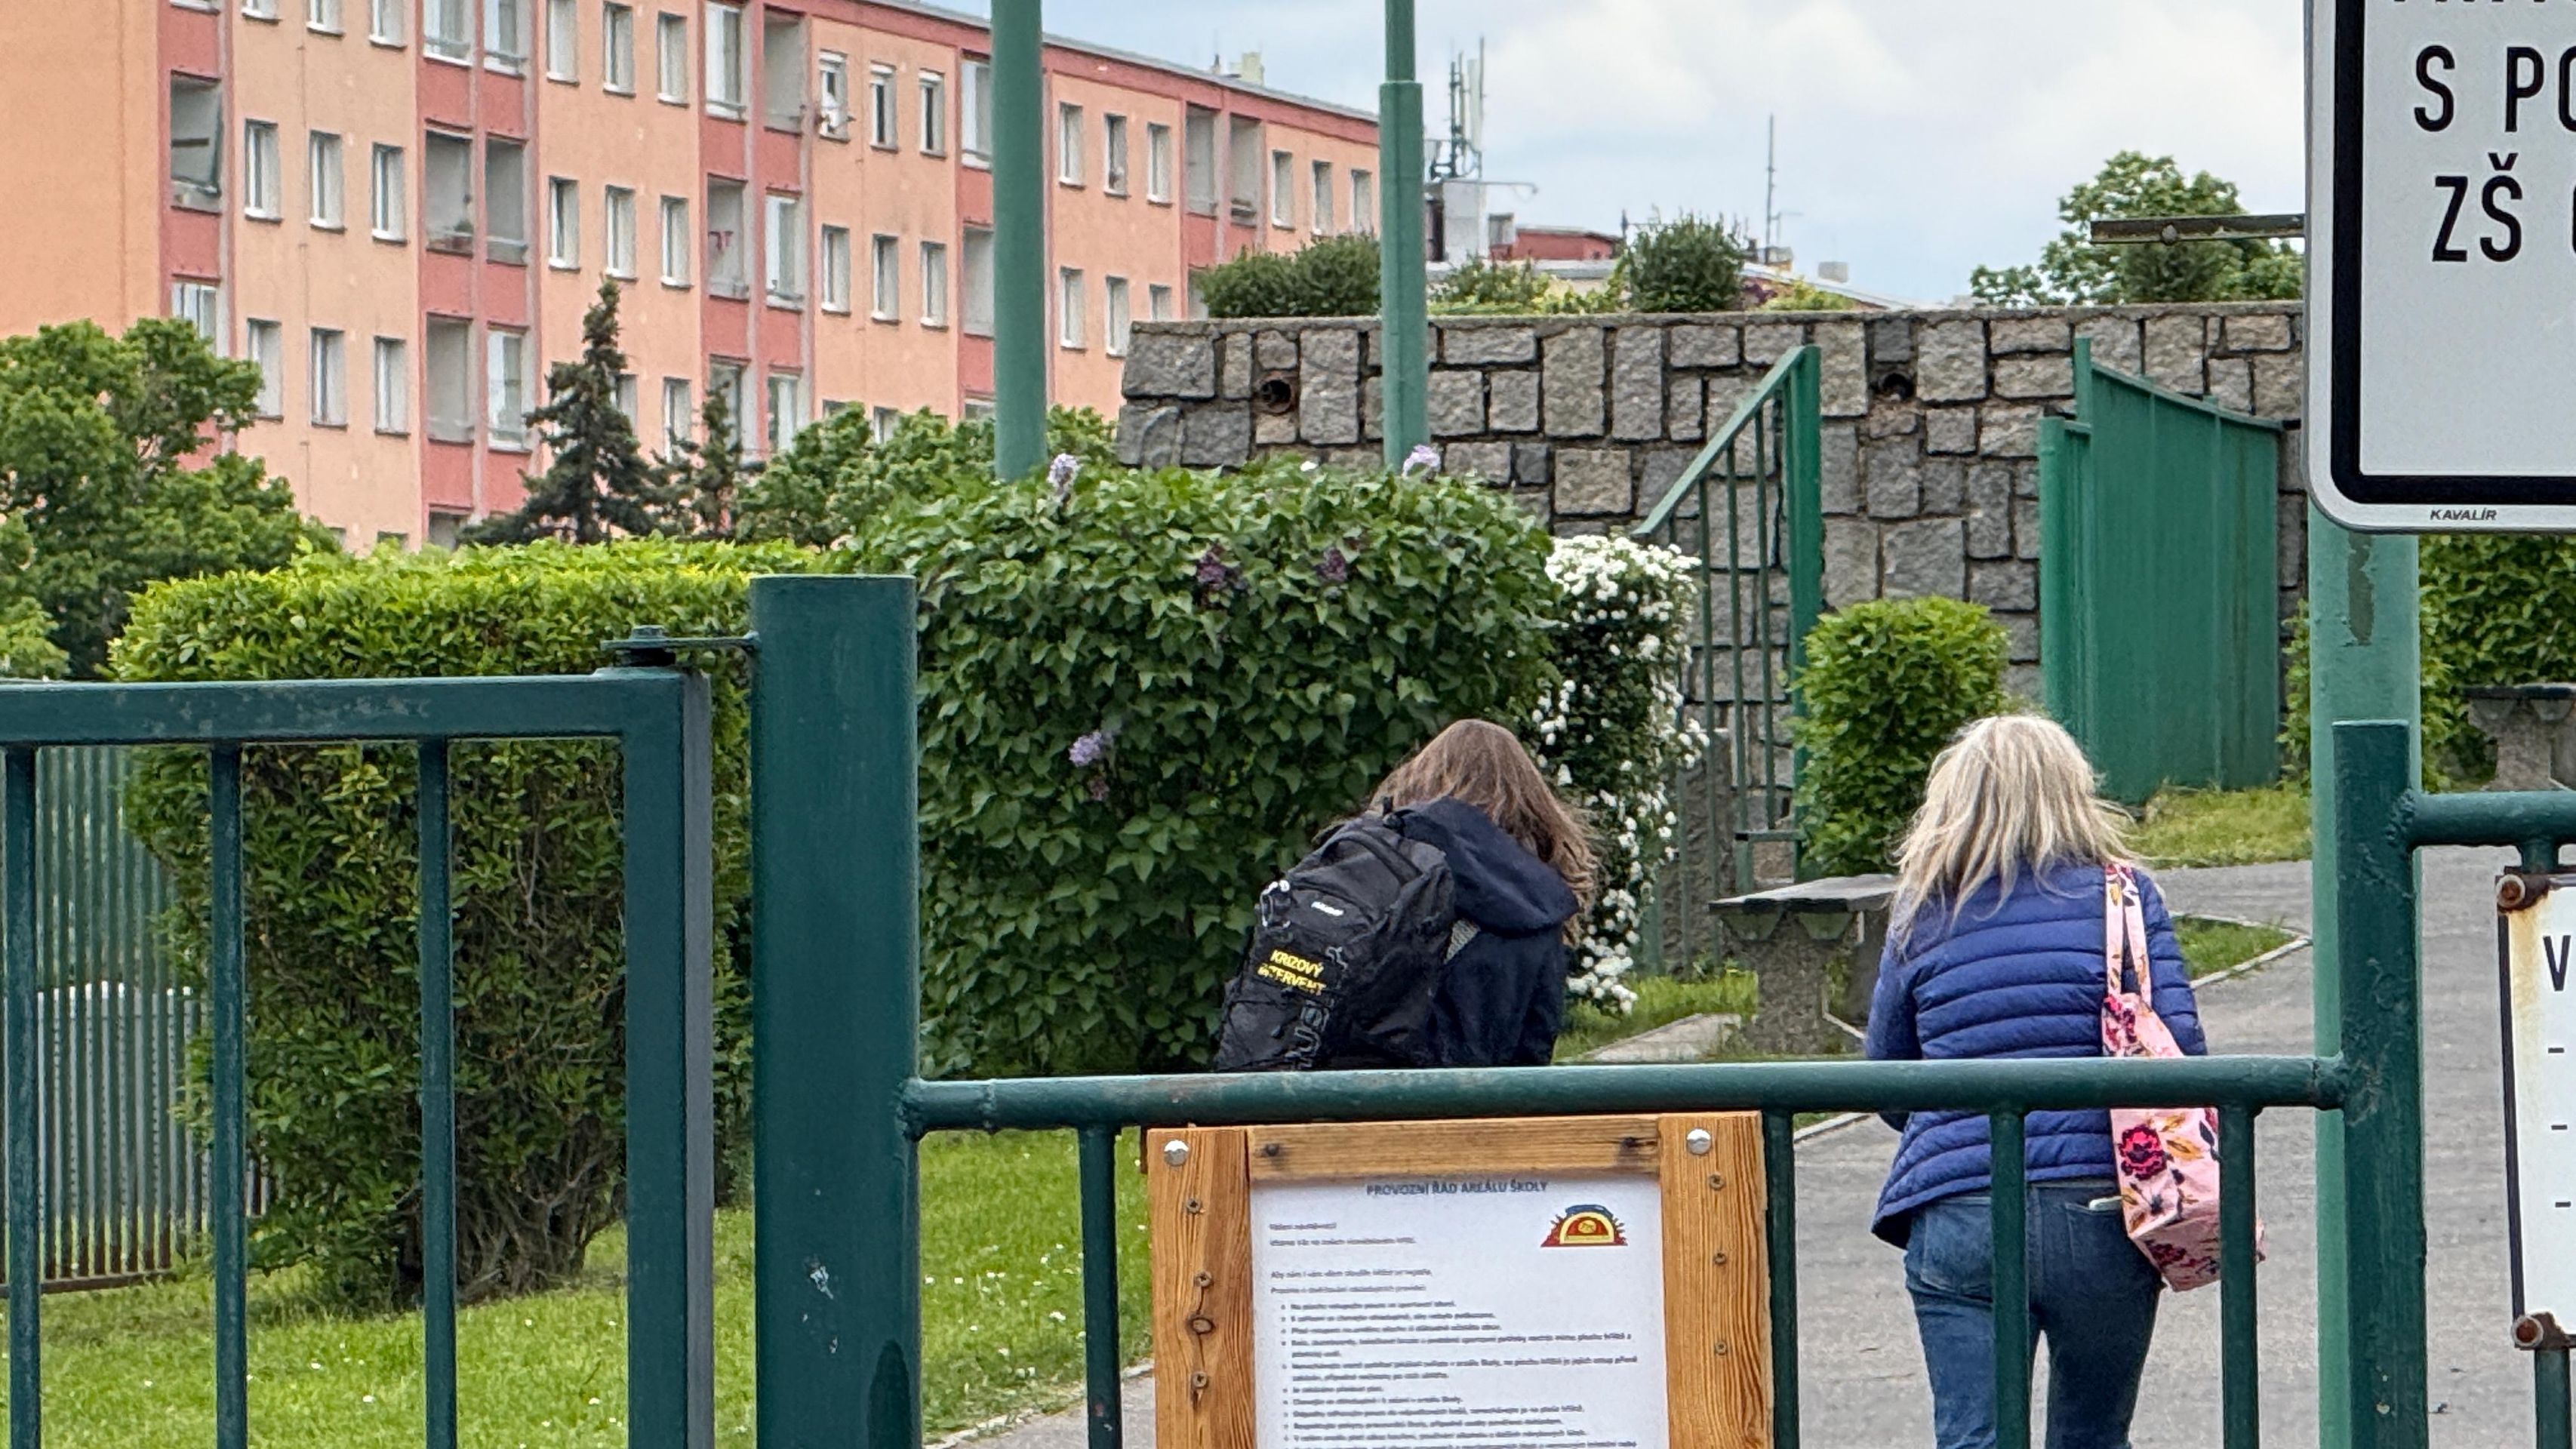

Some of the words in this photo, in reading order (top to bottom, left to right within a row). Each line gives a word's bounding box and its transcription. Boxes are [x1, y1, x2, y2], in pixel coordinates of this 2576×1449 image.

[2414, 45, 2454, 131] S
[2433, 153, 2522, 262] ZŠ
[2430, 507, 2498, 521] KAVALÍR
[2543, 935, 2571, 992] V
